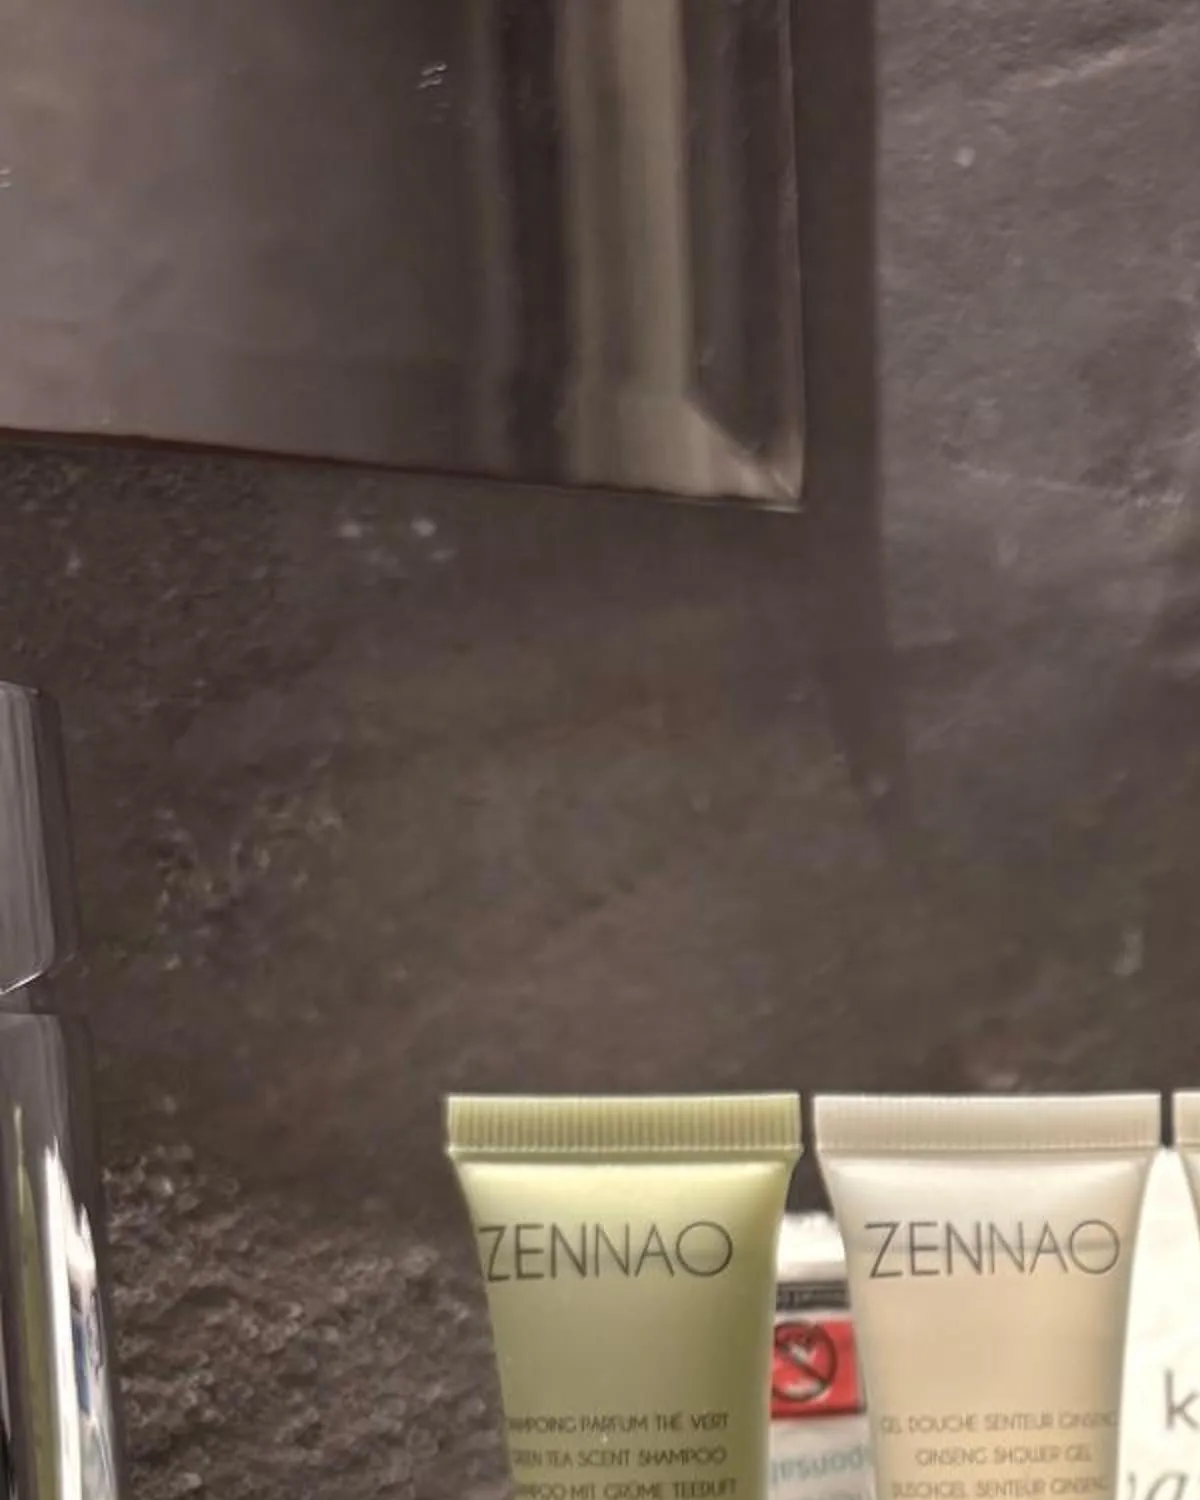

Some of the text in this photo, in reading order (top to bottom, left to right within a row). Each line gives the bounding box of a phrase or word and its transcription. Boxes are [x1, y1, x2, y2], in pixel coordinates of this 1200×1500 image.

[479, 1220, 733, 1282] ZENNAO
[864, 1219, 1121, 1279] ZENNAO
[639, 1445, 728, 1467] SHAMPOO
